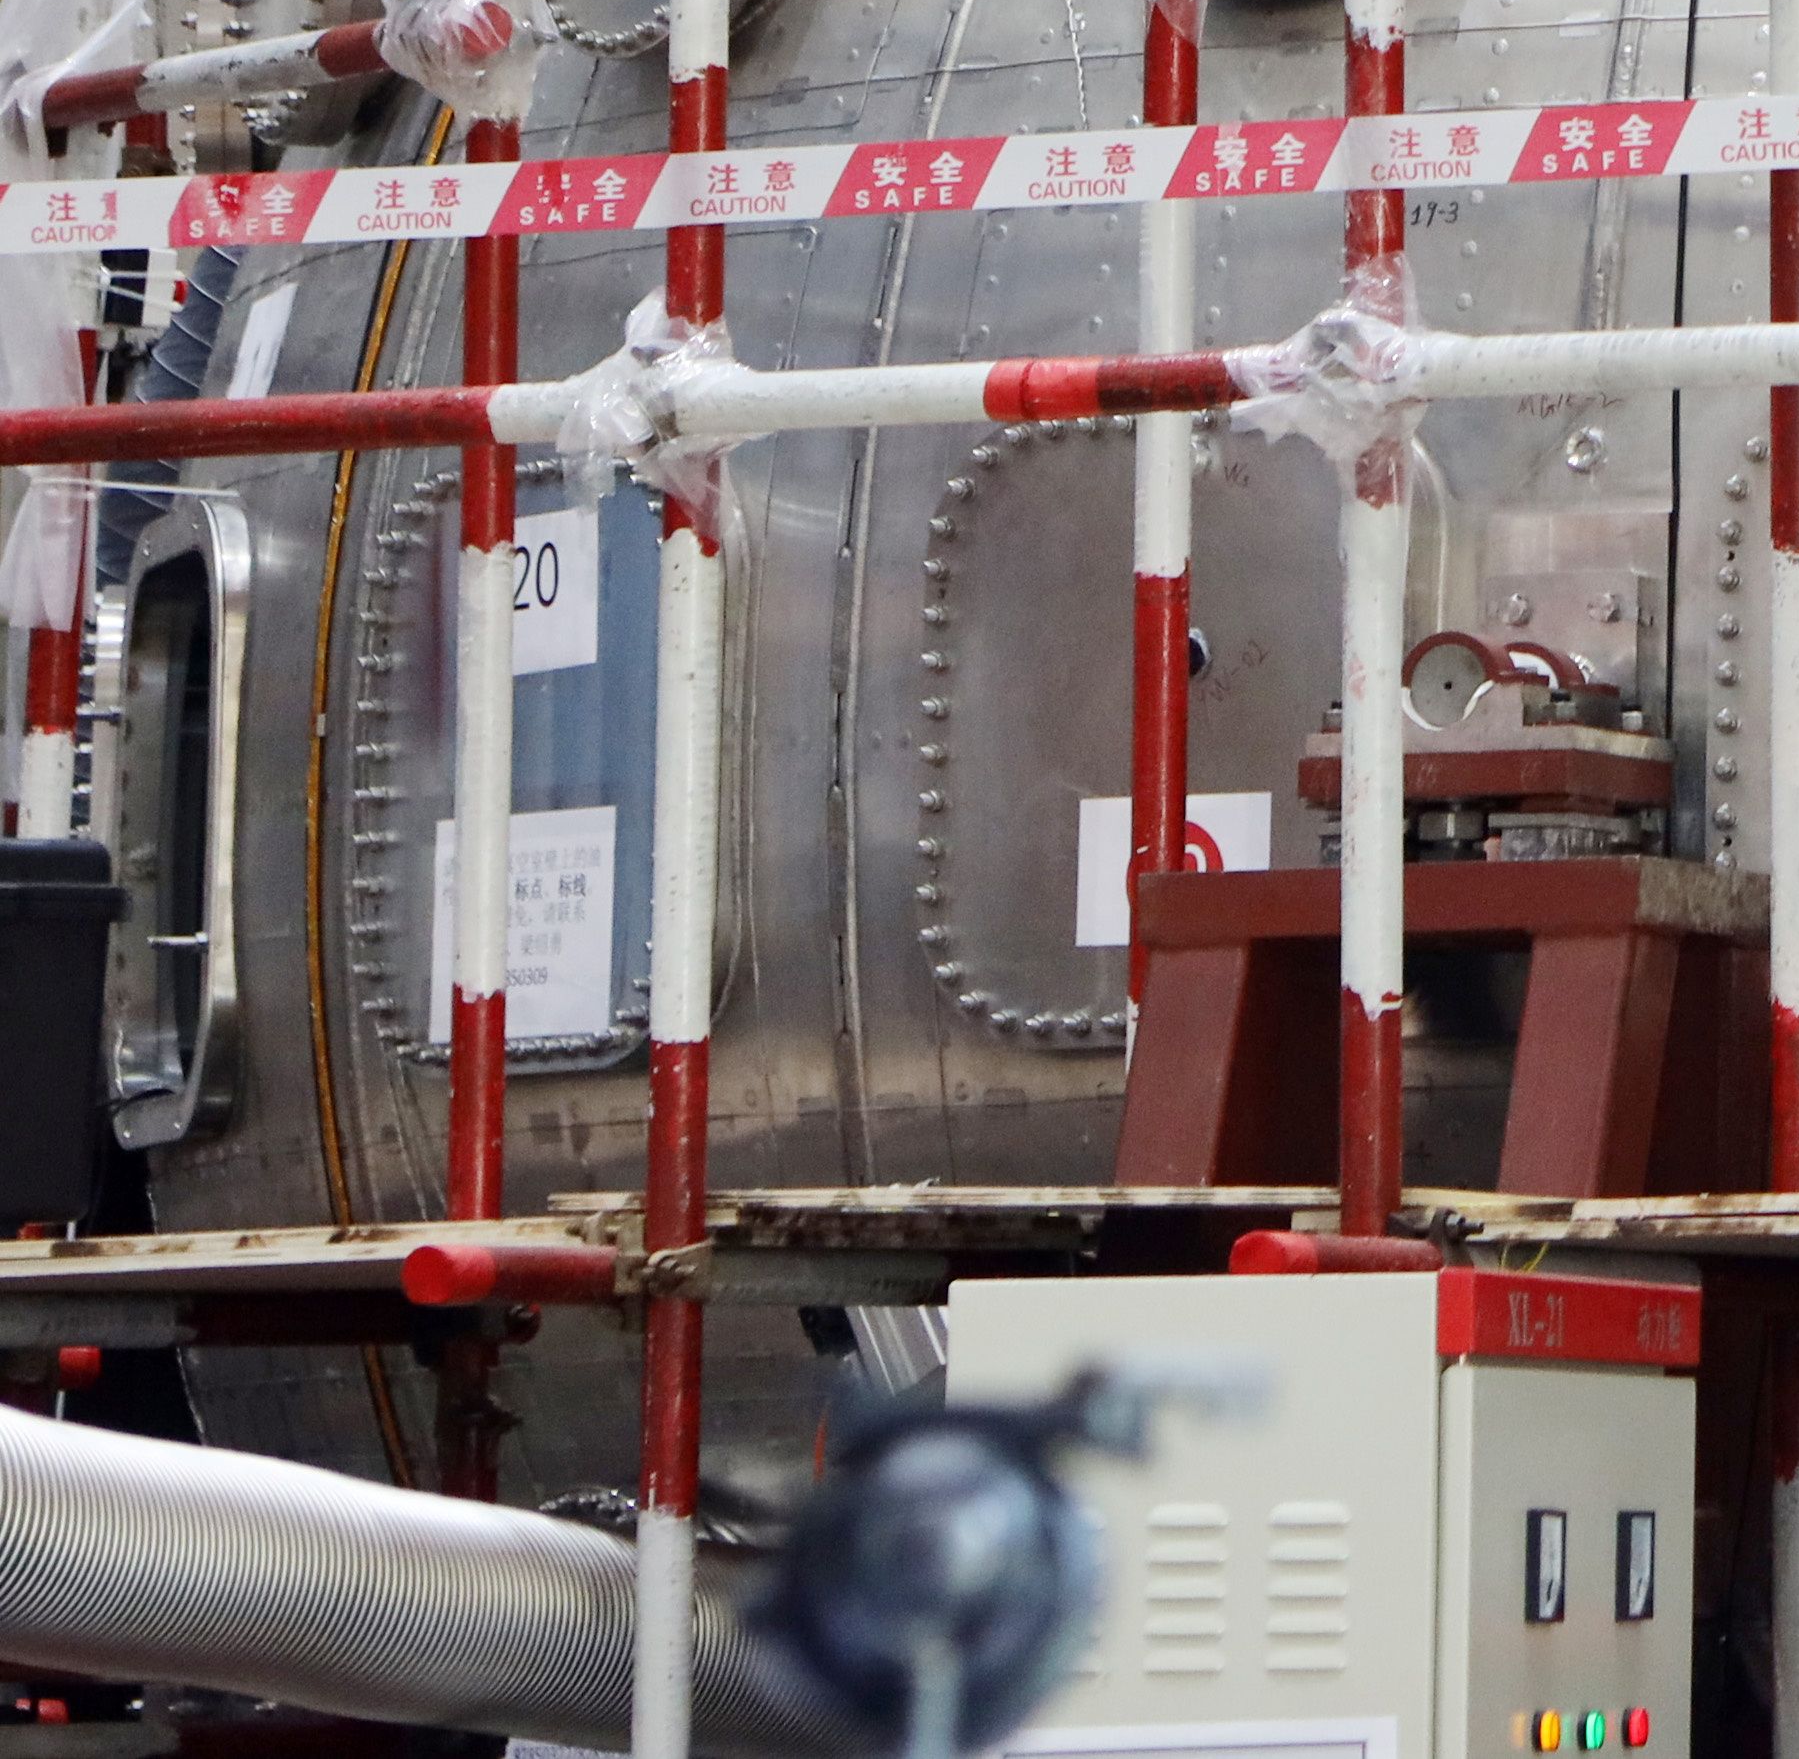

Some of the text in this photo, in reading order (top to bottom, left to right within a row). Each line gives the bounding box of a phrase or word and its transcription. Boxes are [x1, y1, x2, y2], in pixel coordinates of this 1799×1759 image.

[1388, 125, 1481, 159] 注意
[1558, 113, 1654, 153] 安全
[1046, 144, 1136, 177] 注意
[1213, 131, 1306, 172] 安全
[1541, 148, 1644, 174] SAFE
[706, 160, 797, 195] 注意
[872, 151, 965, 189] 安全
[1194, 168, 1298, 193] SAFE
[1370, 160, 1472, 183] CAUTION
[374, 176, 463, 211] 注意
[855, 185, 955, 210] SAFE
[1028, 178, 1126, 201] CAUTION
[519, 202, 616, 227] SAFE
[689, 195, 787, 218] CAUTION
[1410, 200, 1459, 228] 19-3
[188, 218, 287, 240] SAFE
[356, 212, 453, 234] CAUTION
[513, 541, 560, 611] 20
[1508, 1291, 1565, 1347] XL-21
